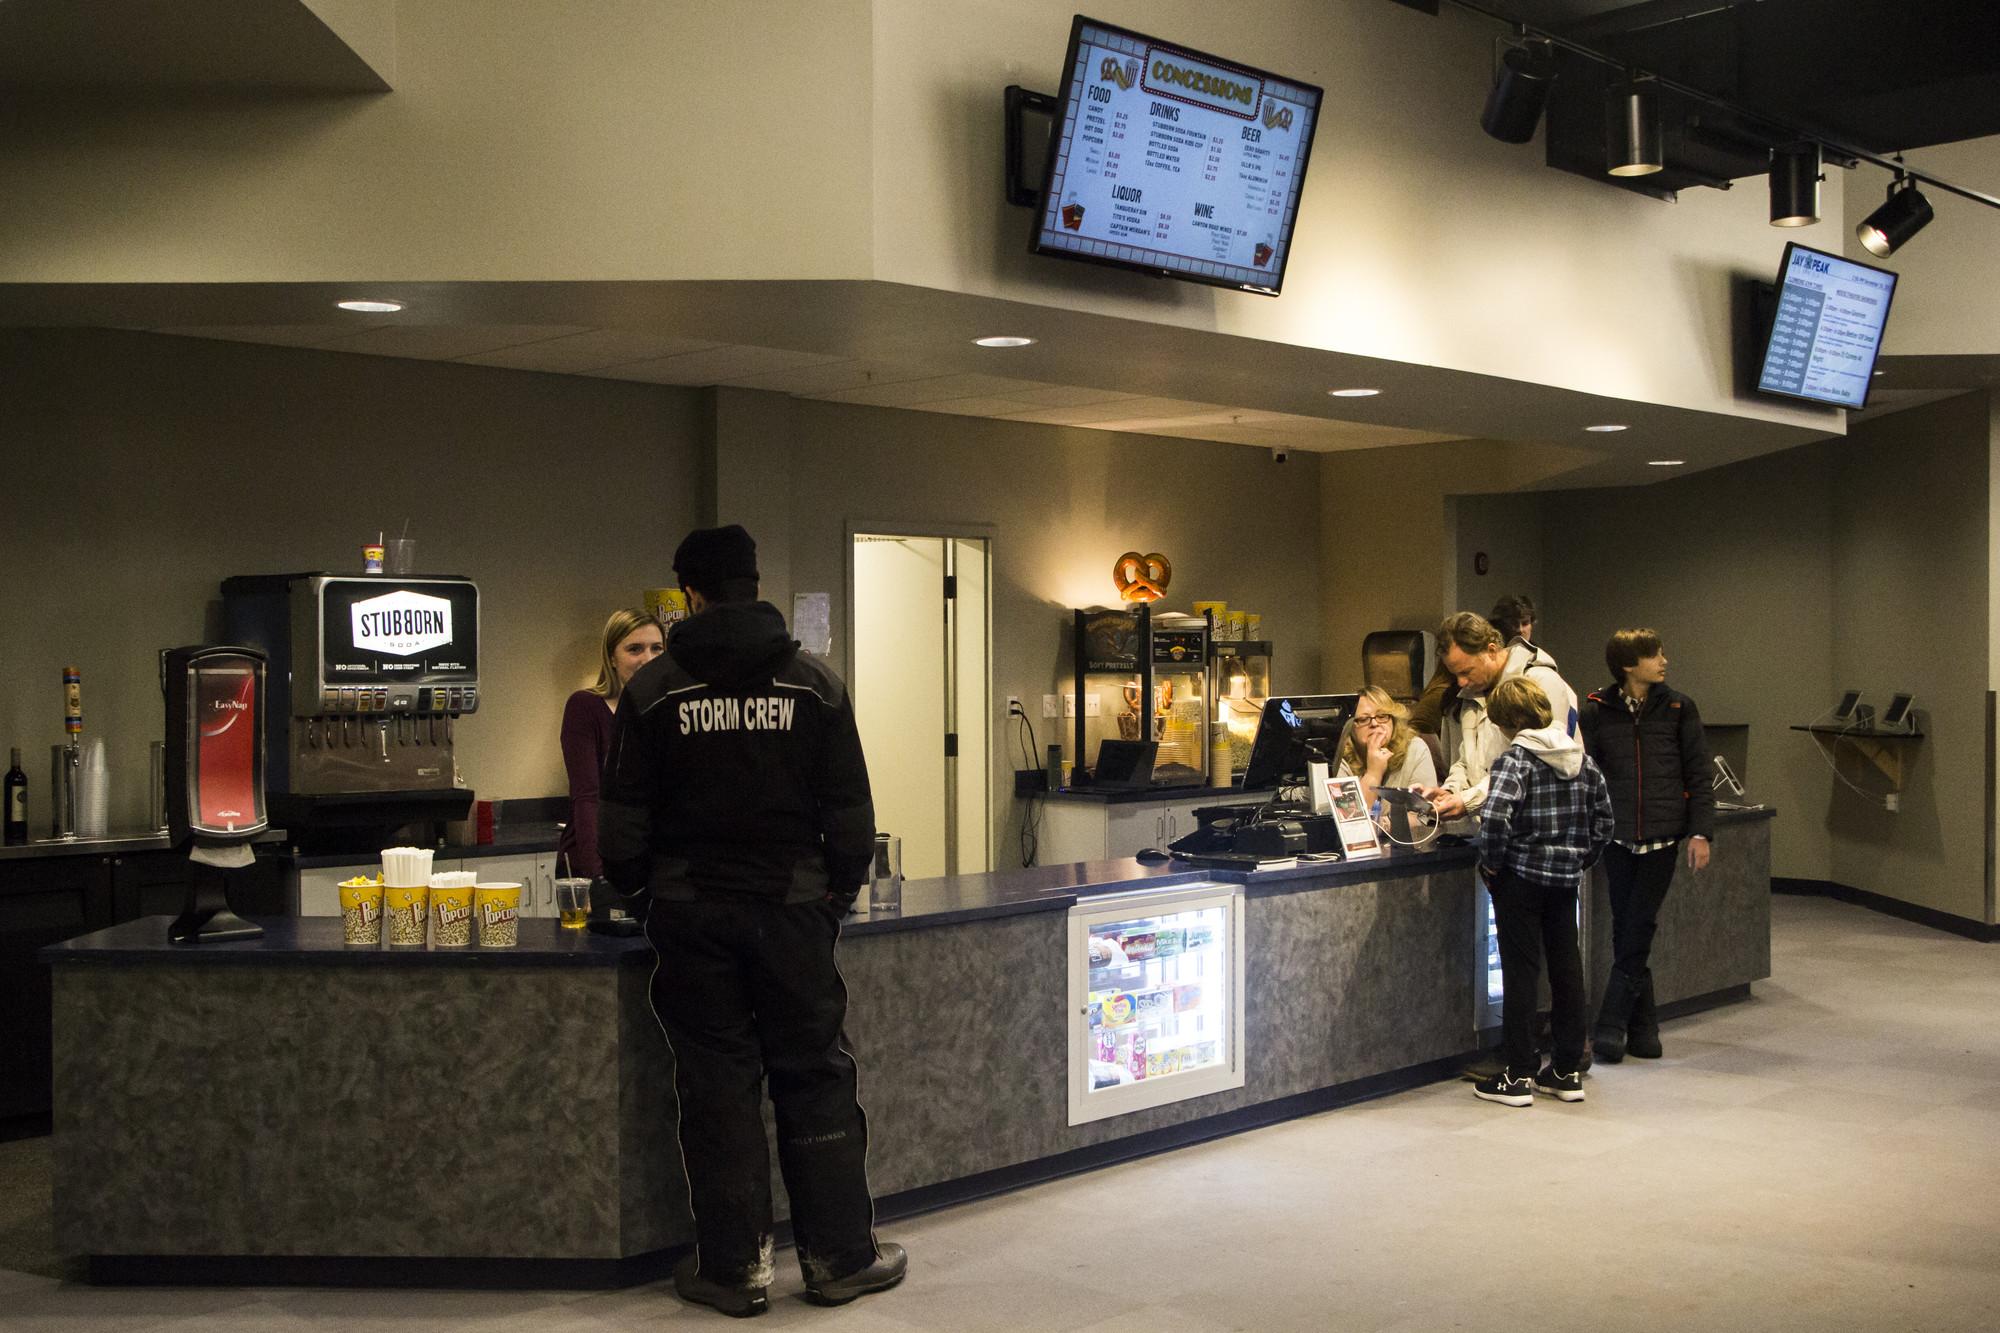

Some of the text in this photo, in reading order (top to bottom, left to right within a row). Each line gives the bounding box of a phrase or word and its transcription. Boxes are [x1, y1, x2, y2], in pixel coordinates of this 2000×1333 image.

[1152, 60, 1253, 105] CONCESSIONS
[1087, 85, 1111, 104] FOOD
[1086, 115, 1105, 125] PRETZEL
[1150, 101, 1180, 122] DRINKS
[1152, 121, 1175, 132] STUBBORN
[1241, 126, 1262, 143] BEER
[1082, 134, 1103, 144] POPCORN
[1150, 130, 1173, 141] STUBBORN
[1148, 140, 1168, 150] BOTTLED
[1146, 150, 1165, 160] BOTTLED
[1112, 184, 1142, 203] LIQUOR
[1194, 202, 1215, 219] WINE
[1110, 223, 1128, 231] CAPTAIN
[1792, 254, 1830, 275] JAY PEAK
[361, 609, 444, 637] STUBBORN
[679, 697, 795, 735] STORM CREW
